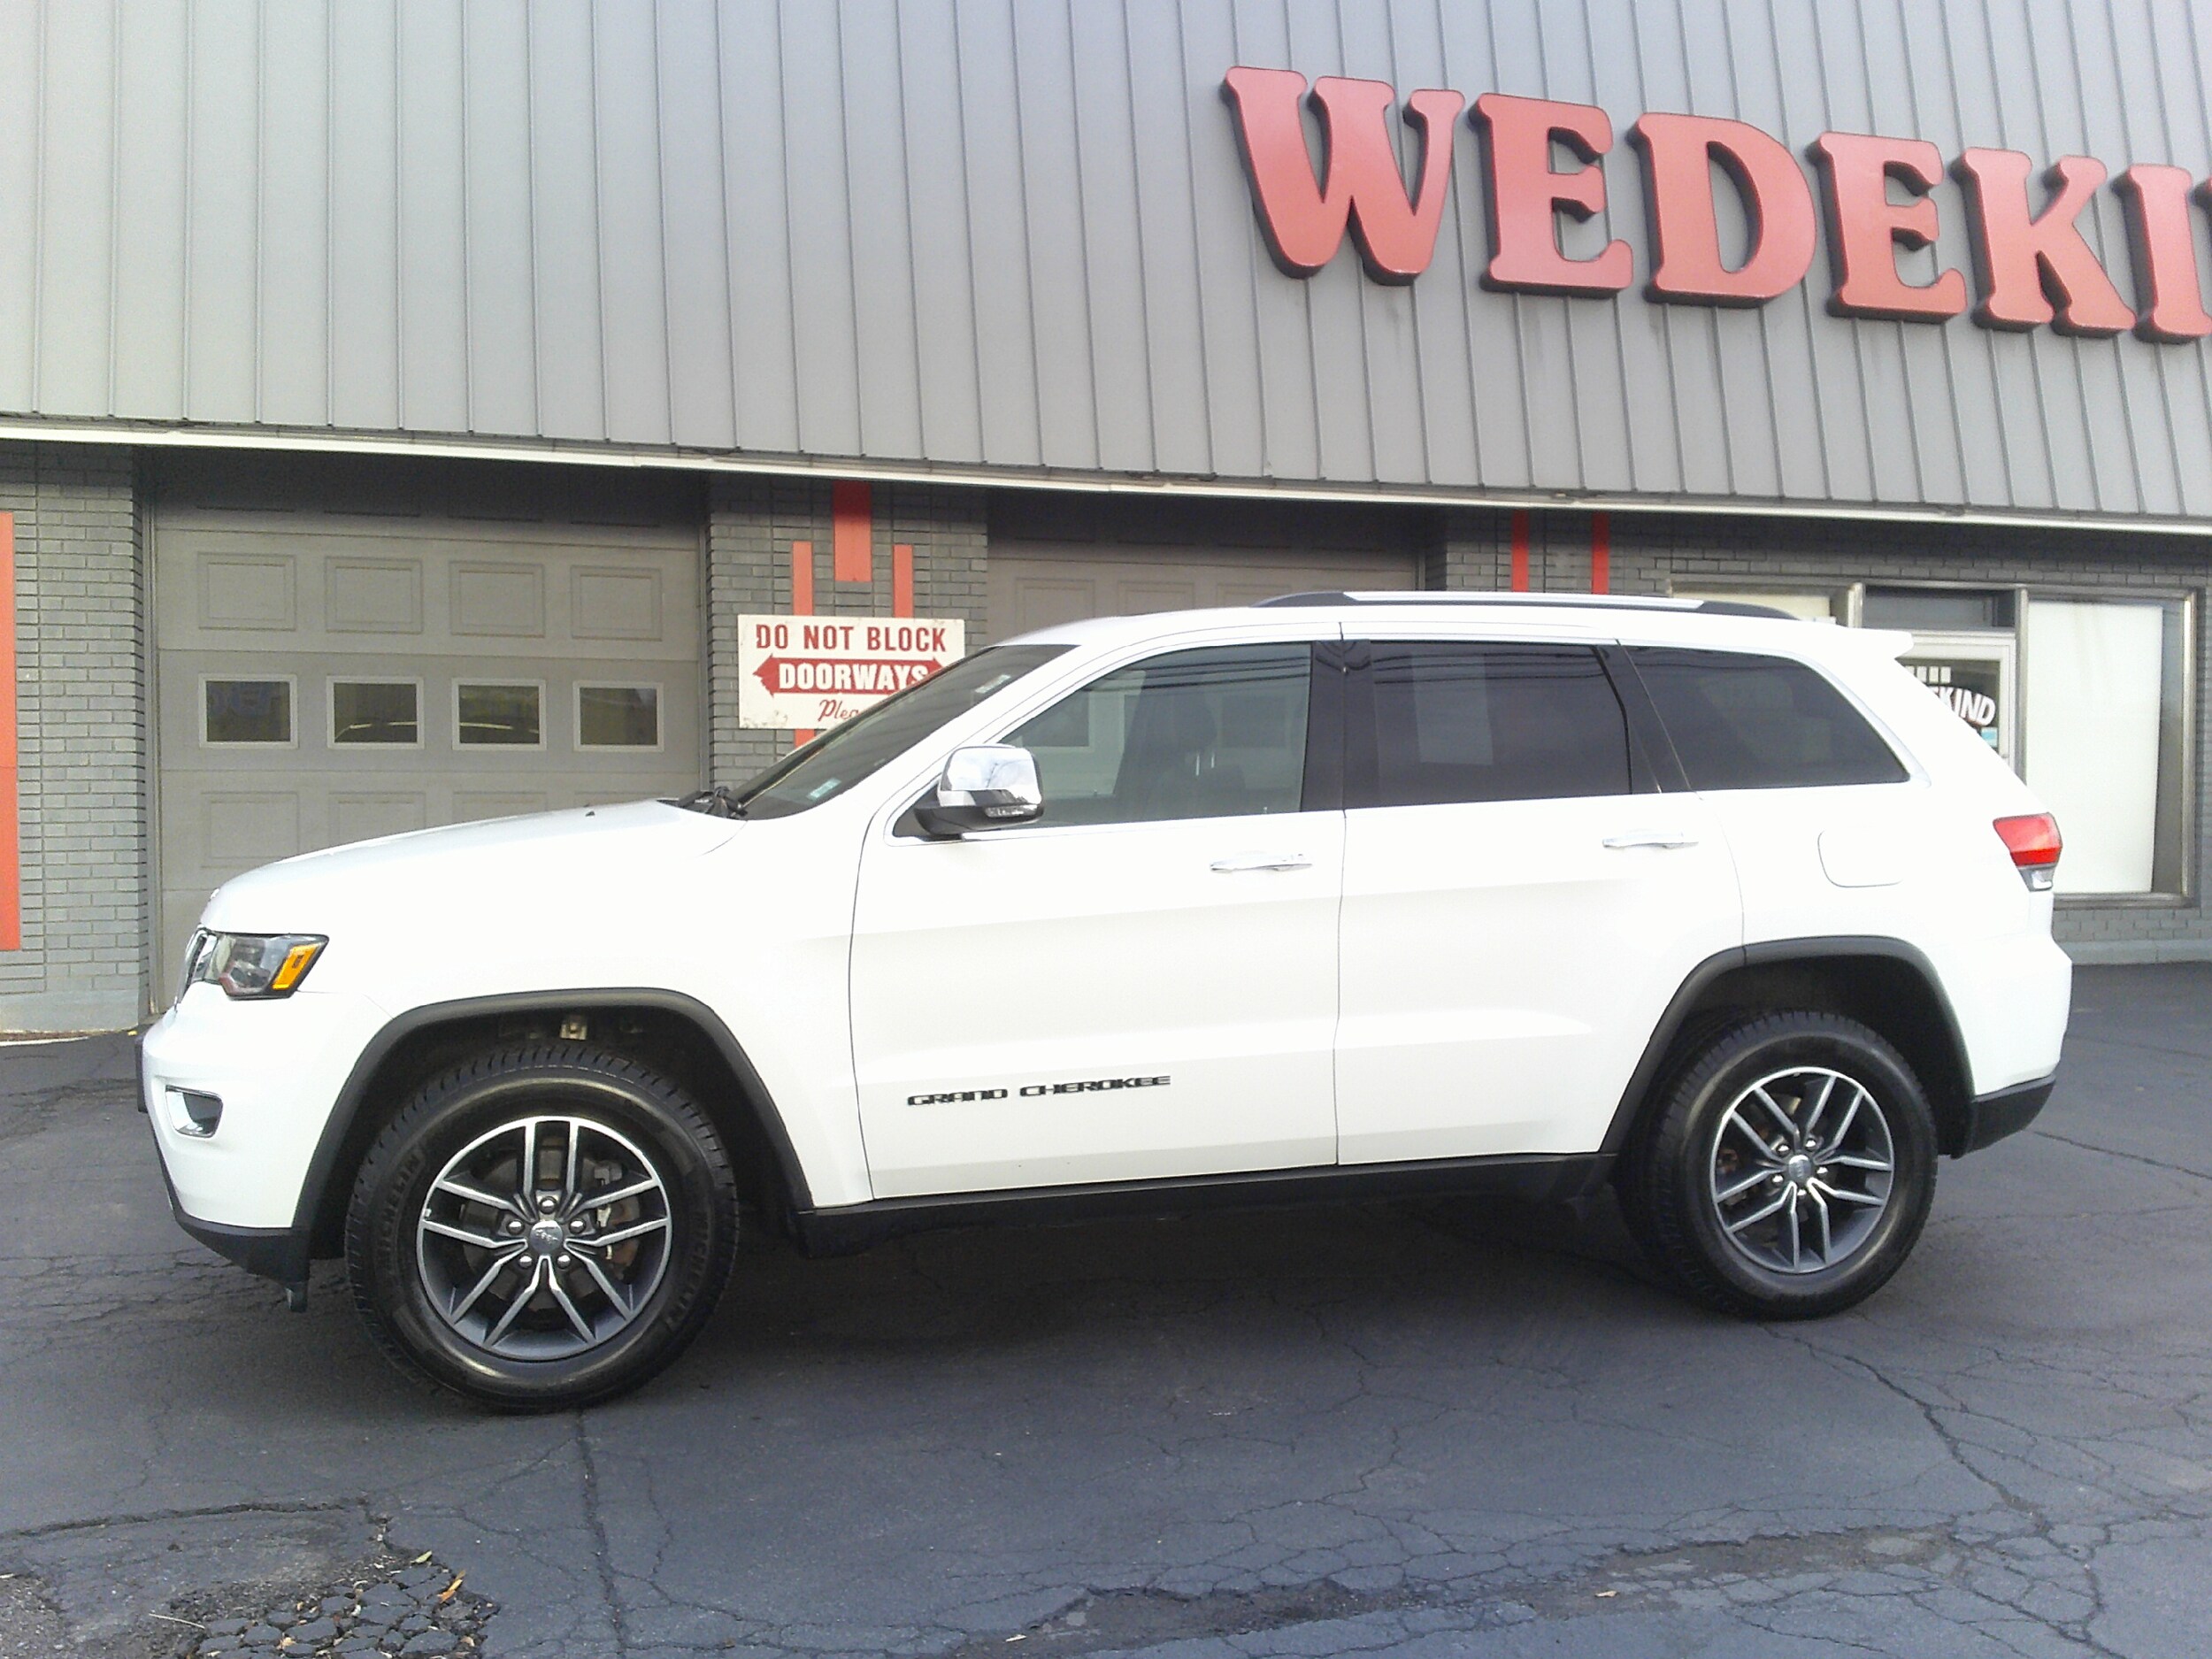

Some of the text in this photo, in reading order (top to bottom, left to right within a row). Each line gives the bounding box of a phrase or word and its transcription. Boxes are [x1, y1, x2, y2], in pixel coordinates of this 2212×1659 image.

[1224, 65, 2212, 343] WEDEKI
[756, 624, 946, 652] DO NOT BLOCK
[779, 663, 928, 690] DOORWAYS
[1928, 686, 1996, 726] KIND
[907, 1075, 1171, 1106] GRAND CHEROKEE
